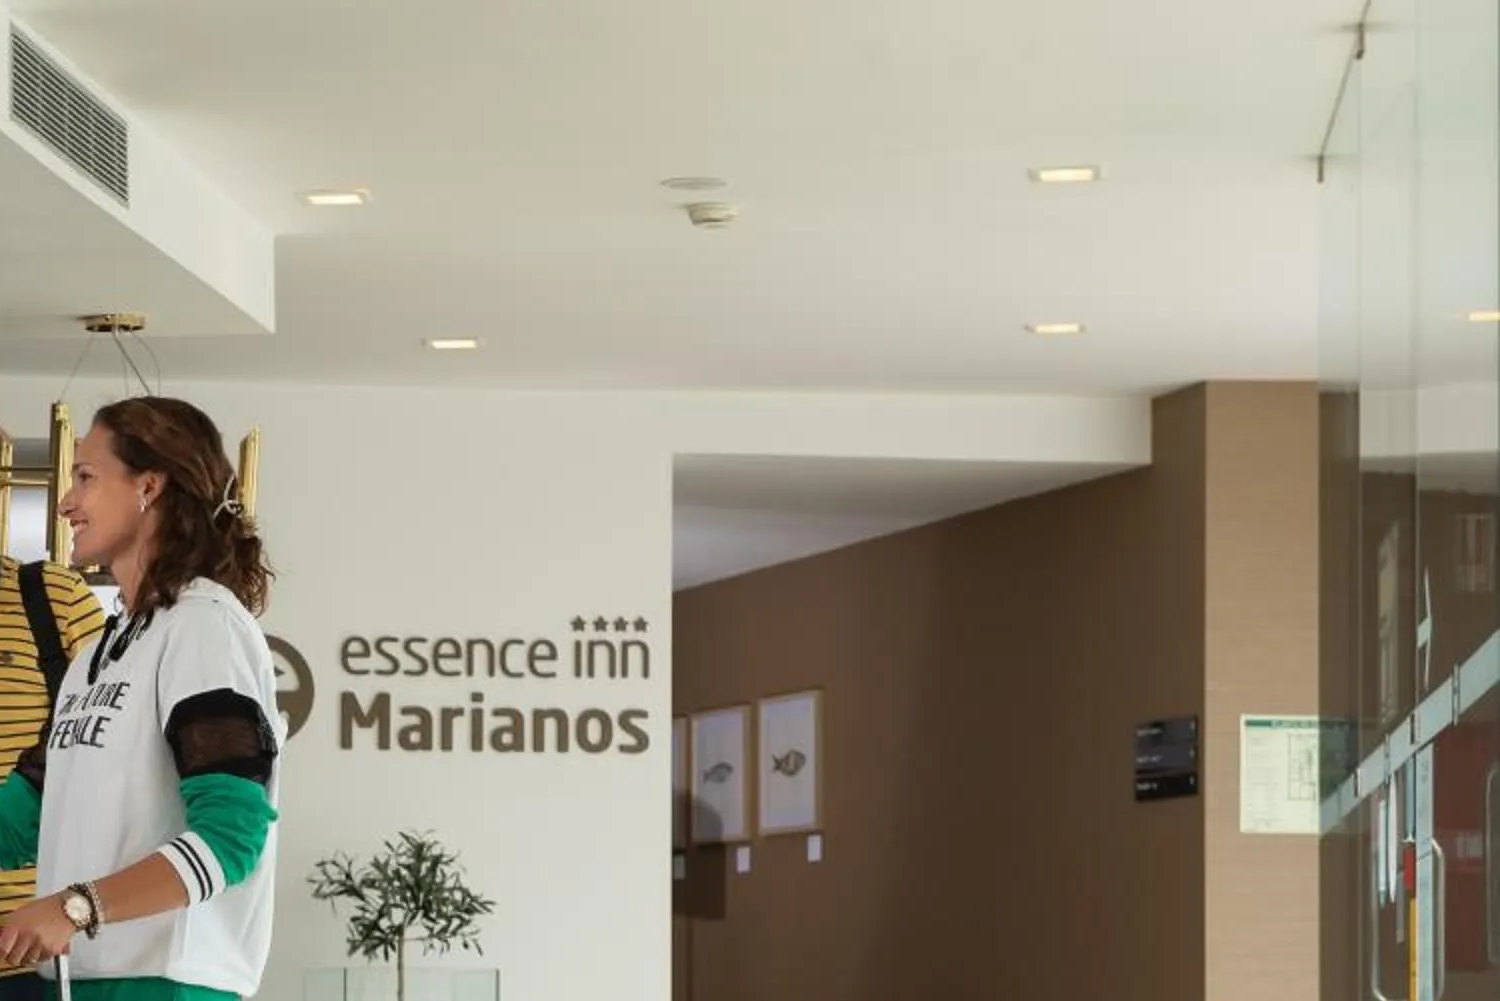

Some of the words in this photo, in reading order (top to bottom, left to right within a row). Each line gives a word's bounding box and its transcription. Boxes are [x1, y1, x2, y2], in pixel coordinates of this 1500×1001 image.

[340, 635, 558, 678] essence
[573, 638, 651, 679] inn
[339, 691, 651, 755] Marianos
